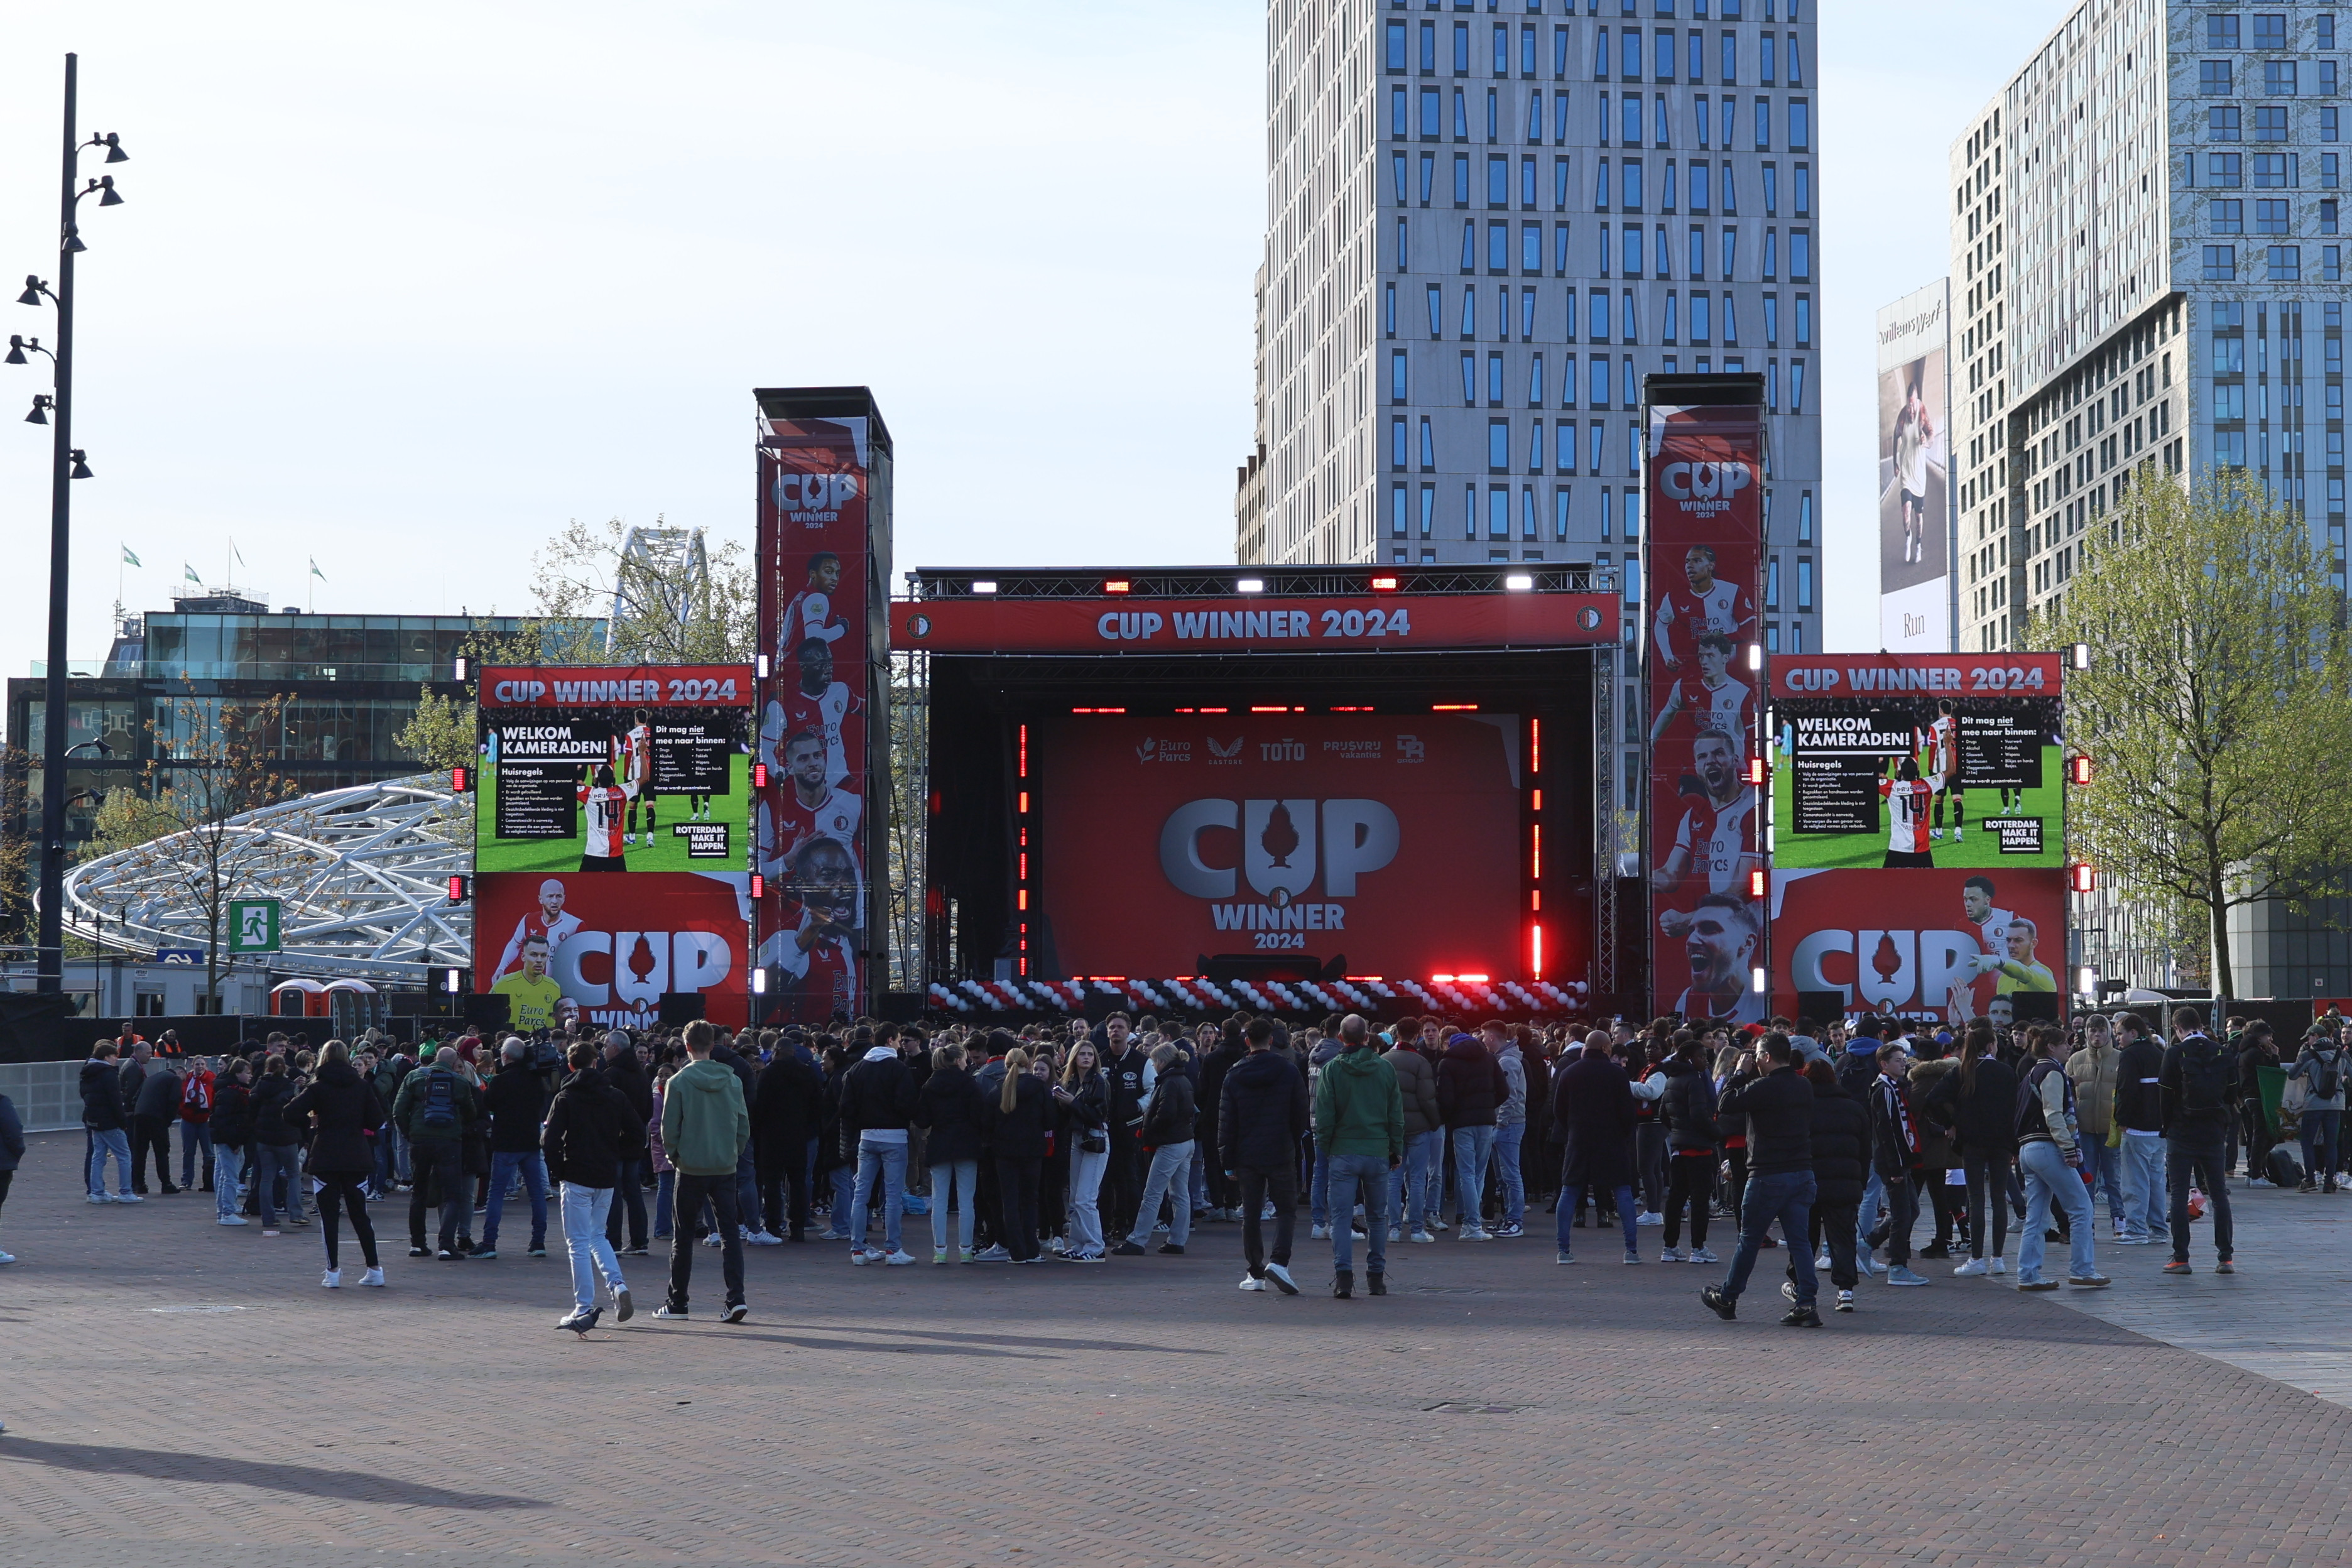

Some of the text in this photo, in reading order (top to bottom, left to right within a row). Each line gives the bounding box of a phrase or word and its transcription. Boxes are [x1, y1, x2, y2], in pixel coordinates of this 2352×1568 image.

[1660, 462, 1751, 499] CUP
[771, 474, 858, 511] CUP
[1679, 501, 1730, 511] WINNER
[790, 511, 838, 522] WINNER
[1097, 609, 1410, 640] CUP WINNER 2024
[1903, 612, 1925, 638] Run
[1785, 667, 2044, 692] CUP WINNER 2024
[495, 678, 737, 702] CUP WINNER 2024
[1797, 718, 1871, 732] WELKOM
[1997, 716, 2013, 724] niet
[503, 726, 572, 740] WELKOM
[689, 725, 704, 733] niet
[1160, 740, 1190, 751] Euro
[1798, 732, 1910, 746] KAMERADEN!
[503, 741, 607, 754] KAMERADEN!
[1260, 739, 1305, 761] TOTO
[1159, 751, 1190, 761] Parcs
[1798, 760, 1842, 770] Huisregels
[502, 768, 543, 777] Huisregels
[596, 800, 620, 828] 14
[1900, 794, 1925, 822] 14
[676, 826, 726, 834] ROTTERDAM.
[1985, 820, 2040, 829] ROTTERDAM.
[2002, 829, 2038, 837] MAKE IT
[1160, 798, 1400, 898] CUP
[1695, 838, 1724, 856] Euro
[2002, 837, 2040, 846] HAPPEN.
[1692, 857, 1728, 874] Parcs
[1212, 904, 1345, 930] WINNER
[1254, 933, 1305, 949] 2024
[553, 931, 731, 1006] CUP
[1791, 929, 1981, 1006] CUP
[520, 1004, 544, 1015] Euro
[518, 1015, 545, 1026] Parcs
[591, 1010, 659, 1030] WINN
